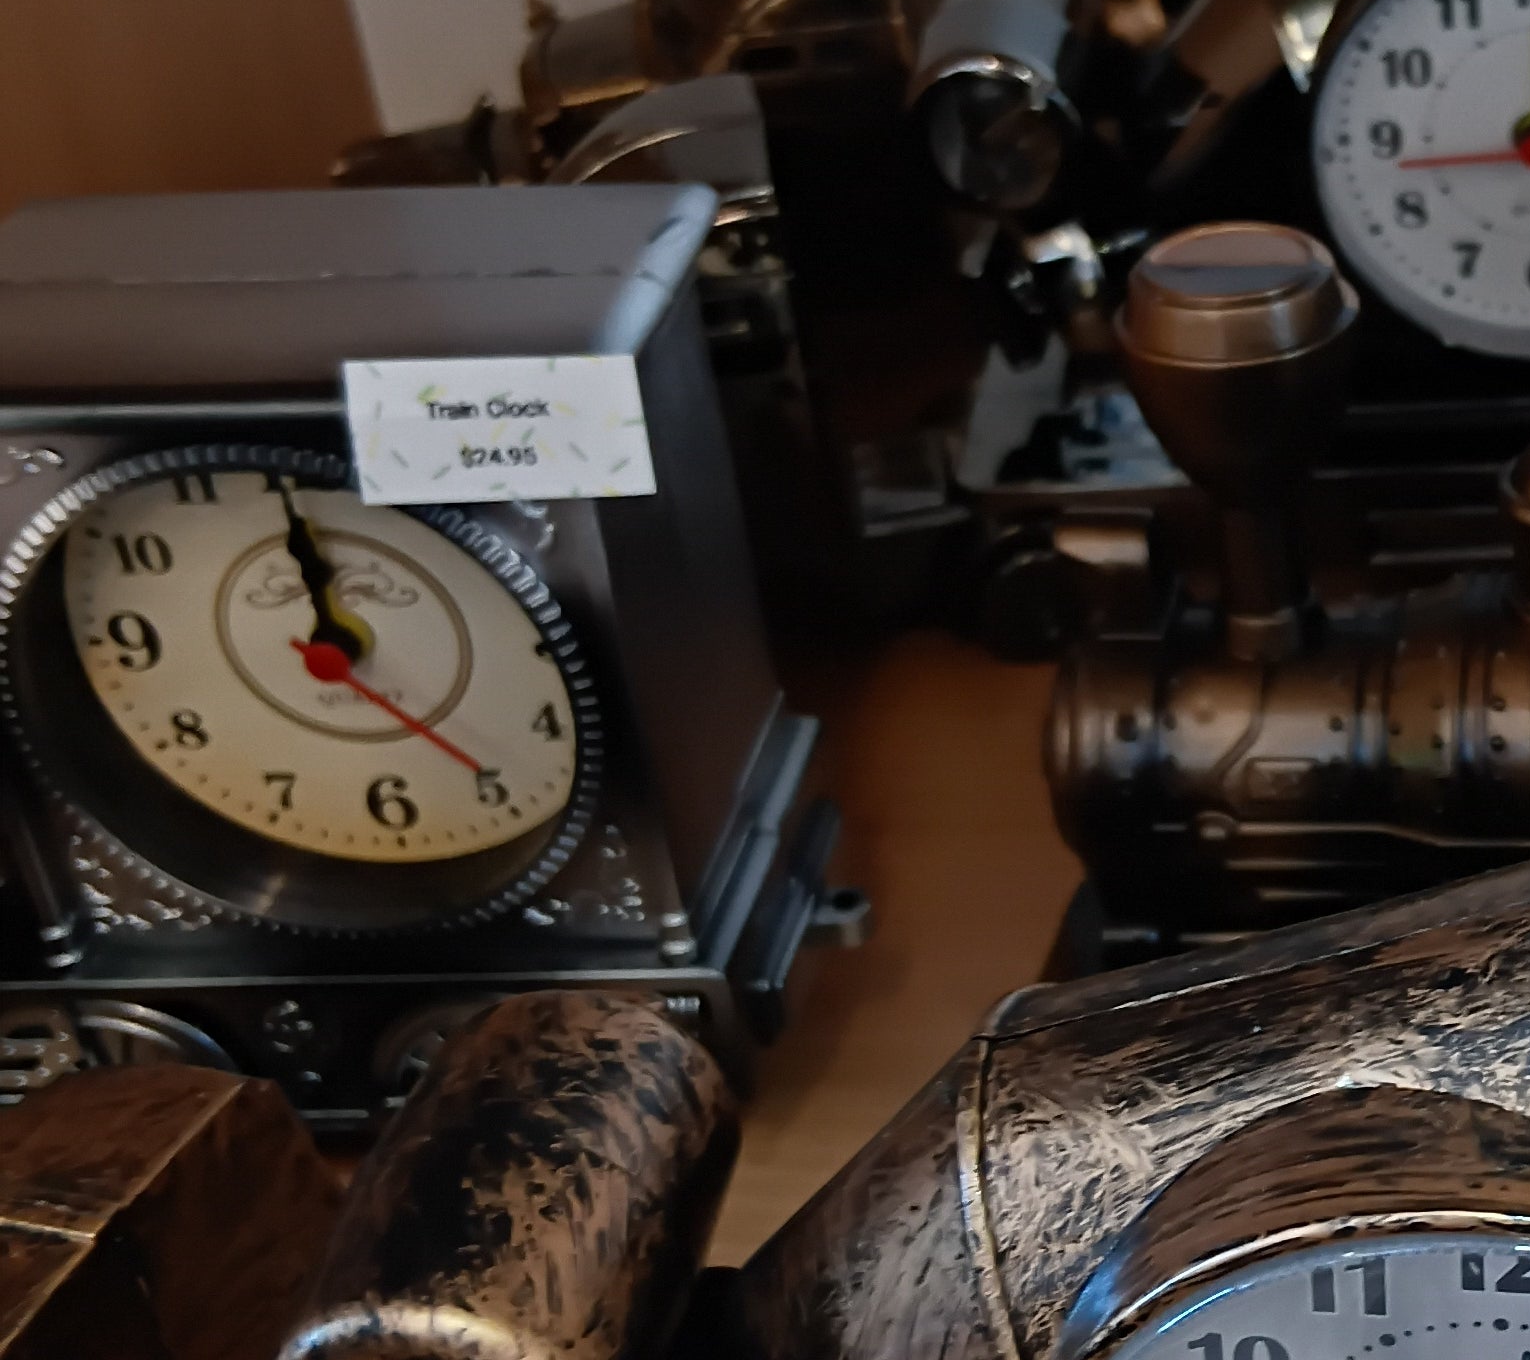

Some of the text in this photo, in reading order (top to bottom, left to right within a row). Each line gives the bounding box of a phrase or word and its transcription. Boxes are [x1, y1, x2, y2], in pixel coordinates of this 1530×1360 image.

[1382, 49, 1431, 89] 10
[1370, 123, 1403, 157] 9
[1396, 192, 1429, 229] 8
[1454, 243, 1483, 279] 7
[426, 398, 549, 420] Train Clock
[114, 532, 173, 575] 10
[107, 610, 160, 672] 9
[170, 709, 208, 750] 8
[533, 703, 562, 742] 4
[265, 771, 296, 810] 7
[367, 776, 419, 830] 6
[477, 769, 509, 807] 5
